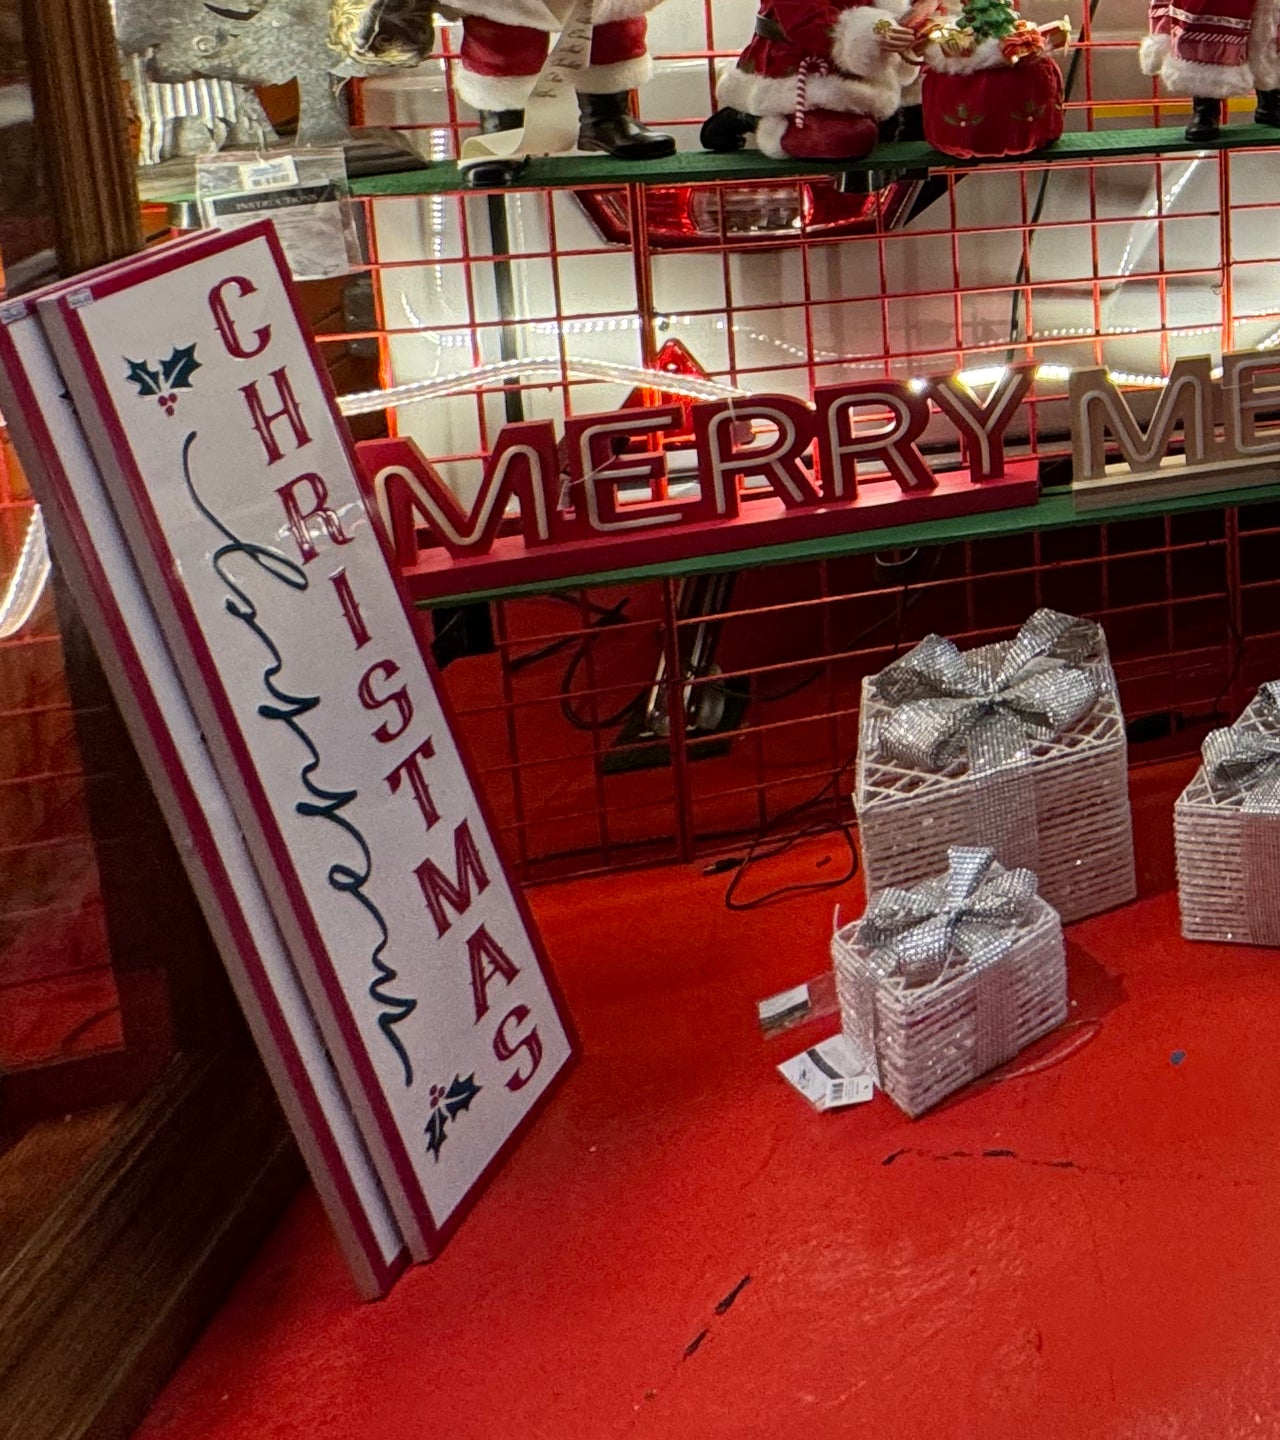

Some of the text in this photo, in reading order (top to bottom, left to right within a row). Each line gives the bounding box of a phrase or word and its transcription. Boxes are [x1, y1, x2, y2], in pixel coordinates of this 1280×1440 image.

[182, 430, 417, 1088] merry
[207, 274, 544, 1093] CHRISTMAS
[356, 365, 1035, 566] MERRY
